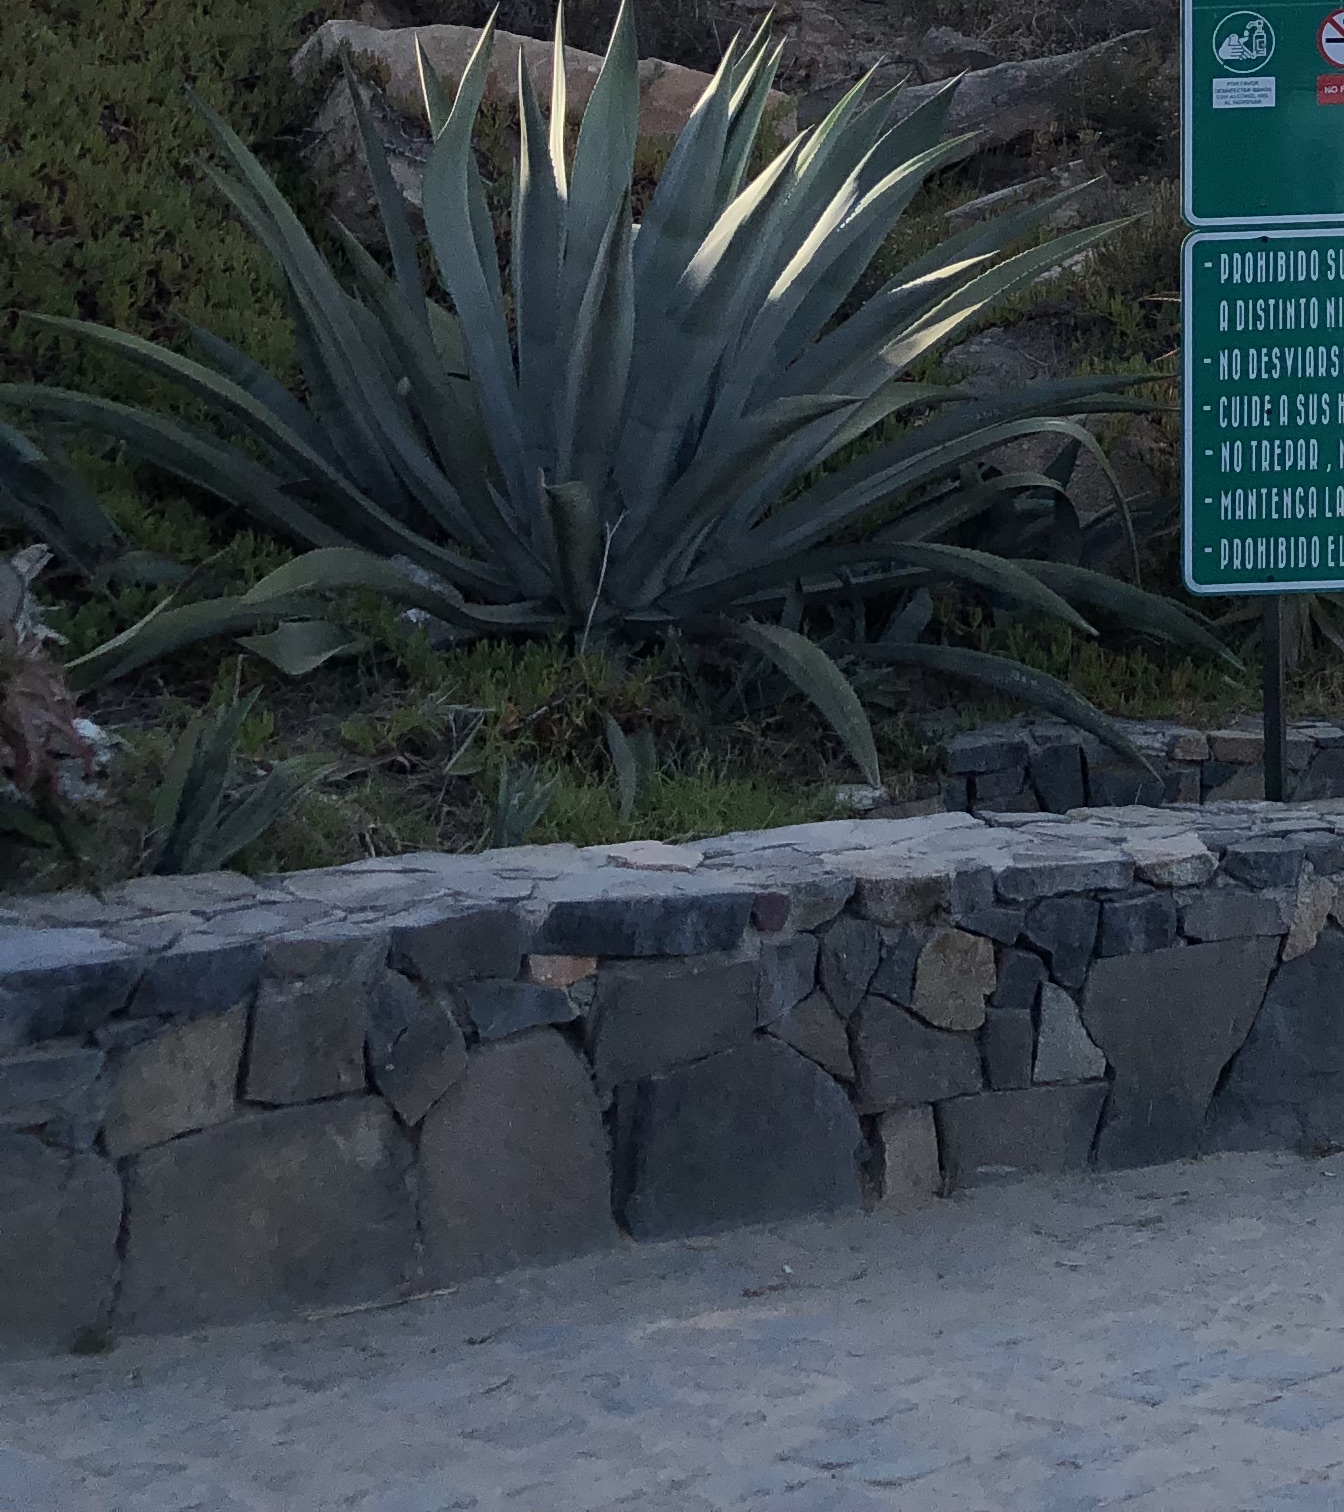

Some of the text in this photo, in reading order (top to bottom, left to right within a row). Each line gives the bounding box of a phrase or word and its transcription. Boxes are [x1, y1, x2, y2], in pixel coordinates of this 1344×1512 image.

[1323, 85, 1338, 94] NO
[1220, 249, 1319, 284] PROHIBIDO
[1219, 300, 1229, 332] A
[1236, 296, 1319, 331] DISTINTO
[1219, 348, 1241, 381] NO
[1219, 394, 1272, 429] CUIDE
[1279, 394, 1288, 426] A
[1296, 392, 1330, 426] SUS
[1221, 440, 1242, 473] NO
[1220, 486, 1317, 521] MANTENGA
[1325, 485, 1344, 518] LA
[1220, 535, 1320, 570] PROHIBIDO
